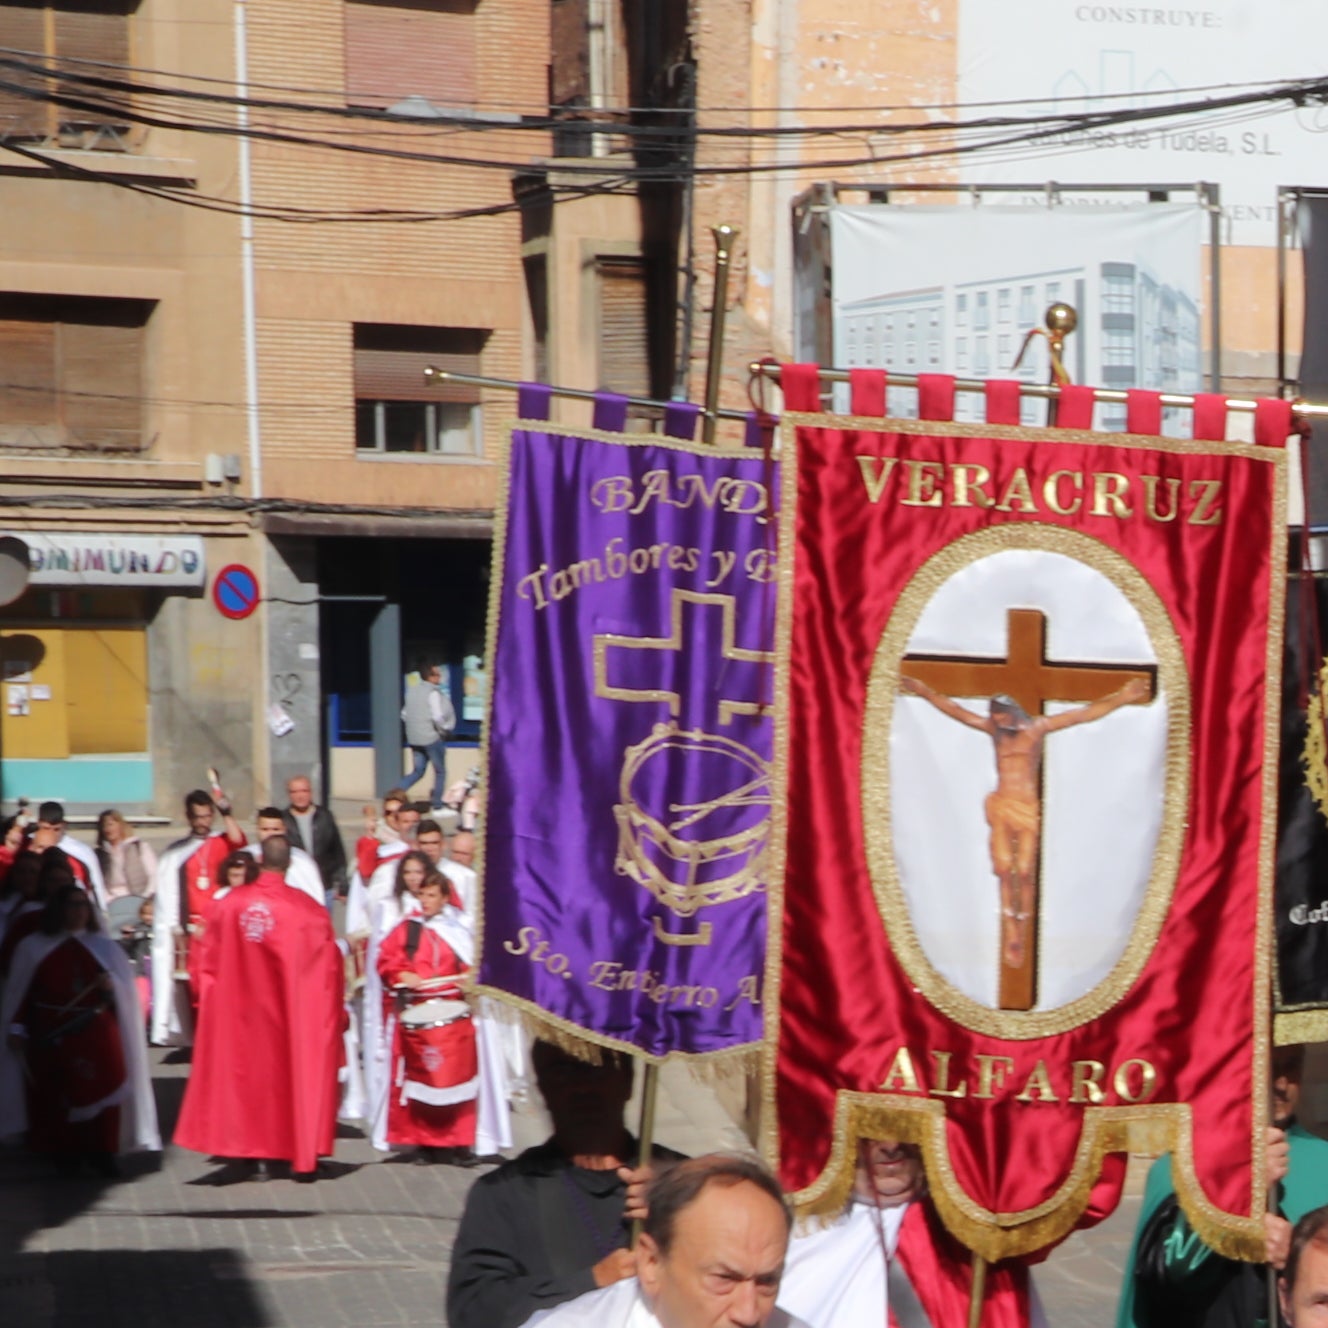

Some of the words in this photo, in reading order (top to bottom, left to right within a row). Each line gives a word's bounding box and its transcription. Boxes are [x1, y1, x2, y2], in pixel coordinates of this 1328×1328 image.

[1075, 5, 1223, 29] CONSTRUYE:
[855, 455, 1222, 526] VERACRUZ
[517, 537, 701, 610] Tambores
[705, 550, 737, 588] y
[503, 926, 573, 979] Sto.
[588, 961, 719, 1009] Entierro
[879, 1047, 1157, 1104] ALFARO
